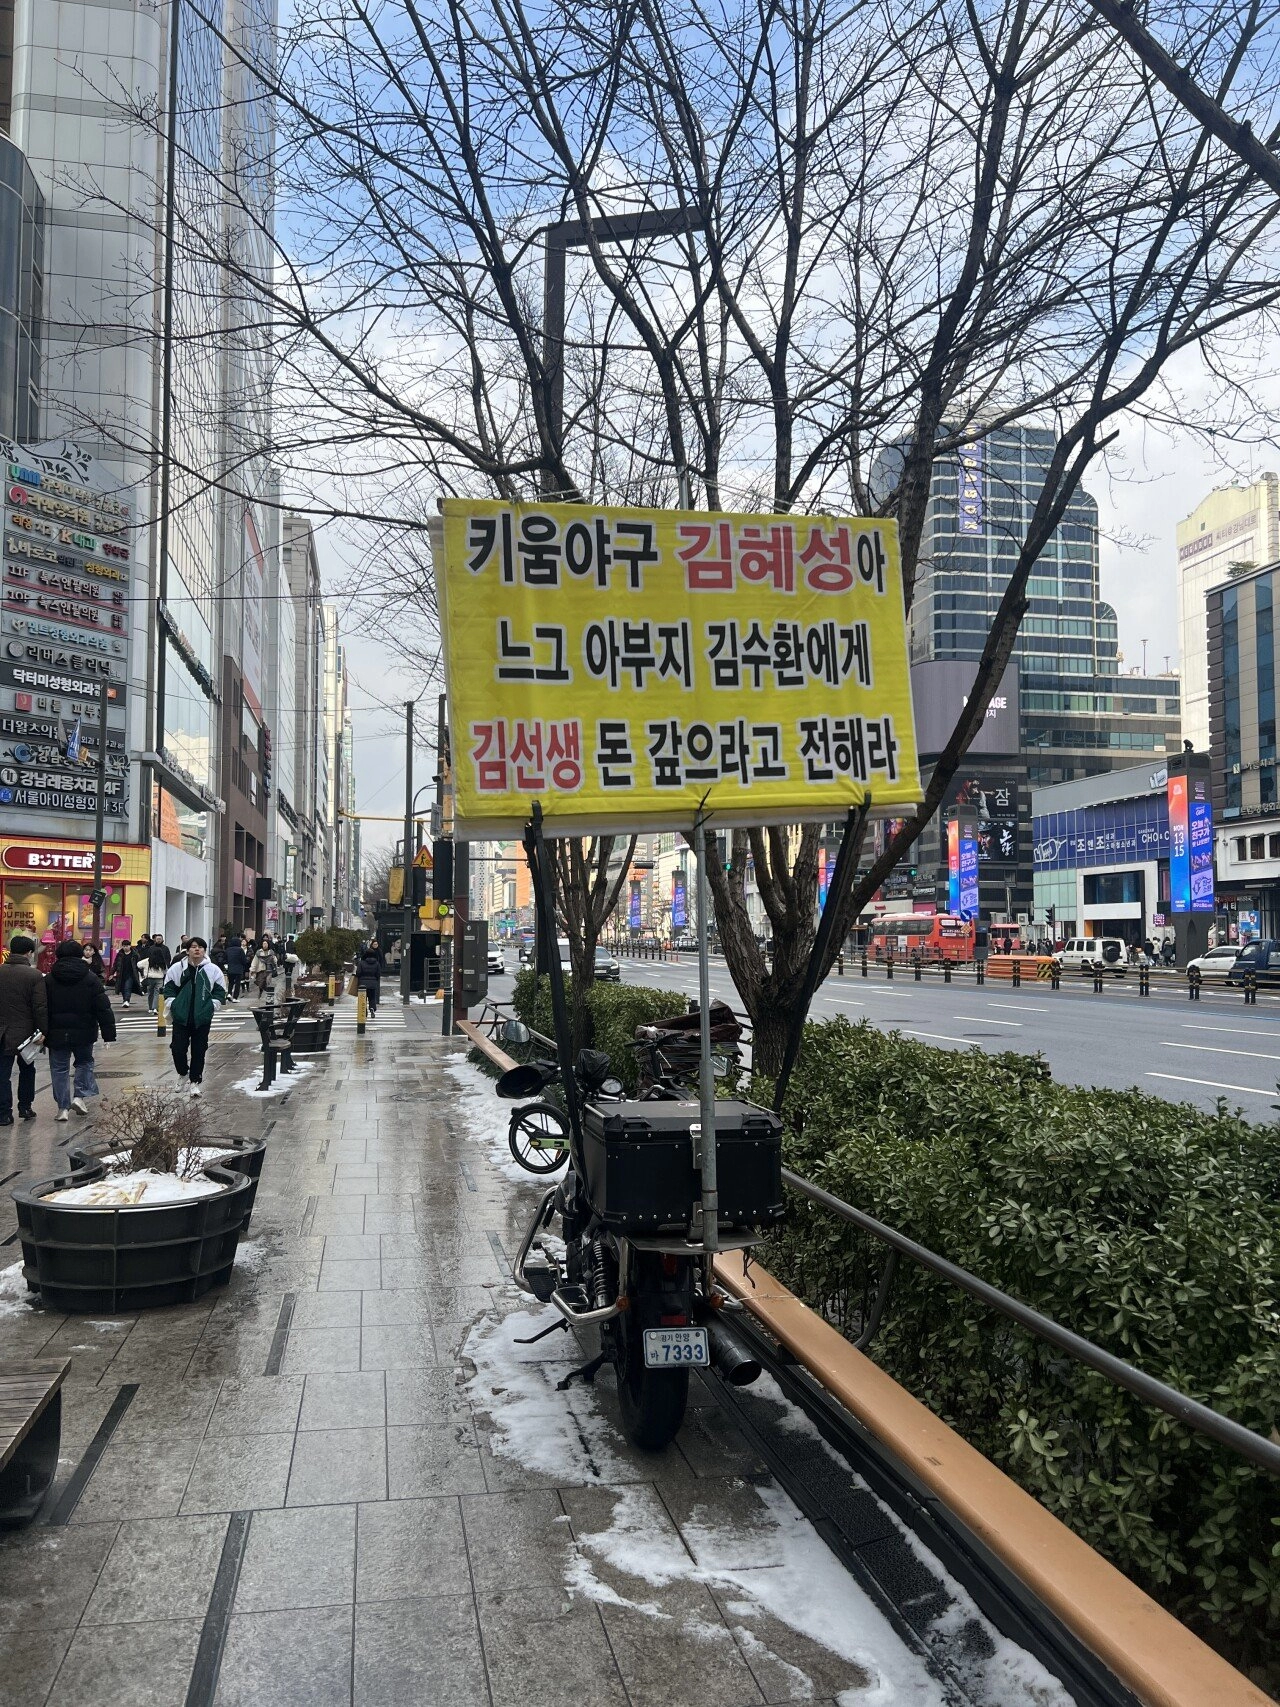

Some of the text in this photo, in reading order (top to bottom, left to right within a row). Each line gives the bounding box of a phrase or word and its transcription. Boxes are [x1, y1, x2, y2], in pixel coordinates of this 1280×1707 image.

[468, 513, 886, 593] 키움야구 김혜성아
[499, 619, 872, 688] 느그 아부지 김수환에게
[12, 668, 94, 696] 닥터미성형외과
[473, 718, 897, 790] 김선생 돈 갚으라고 전해라
[104, 781, 121, 795] 4F
[995, 788, 1010, 806] 잠
[111, 803, 124, 813] 3F
[1141, 833, 1159, 843] CHO
[1174, 832, 1184, 844] 13
[1174, 845, 1185, 857] 15
[28, 852, 95, 868] BUTTER
[662, 1344, 704, 1361] 7333
